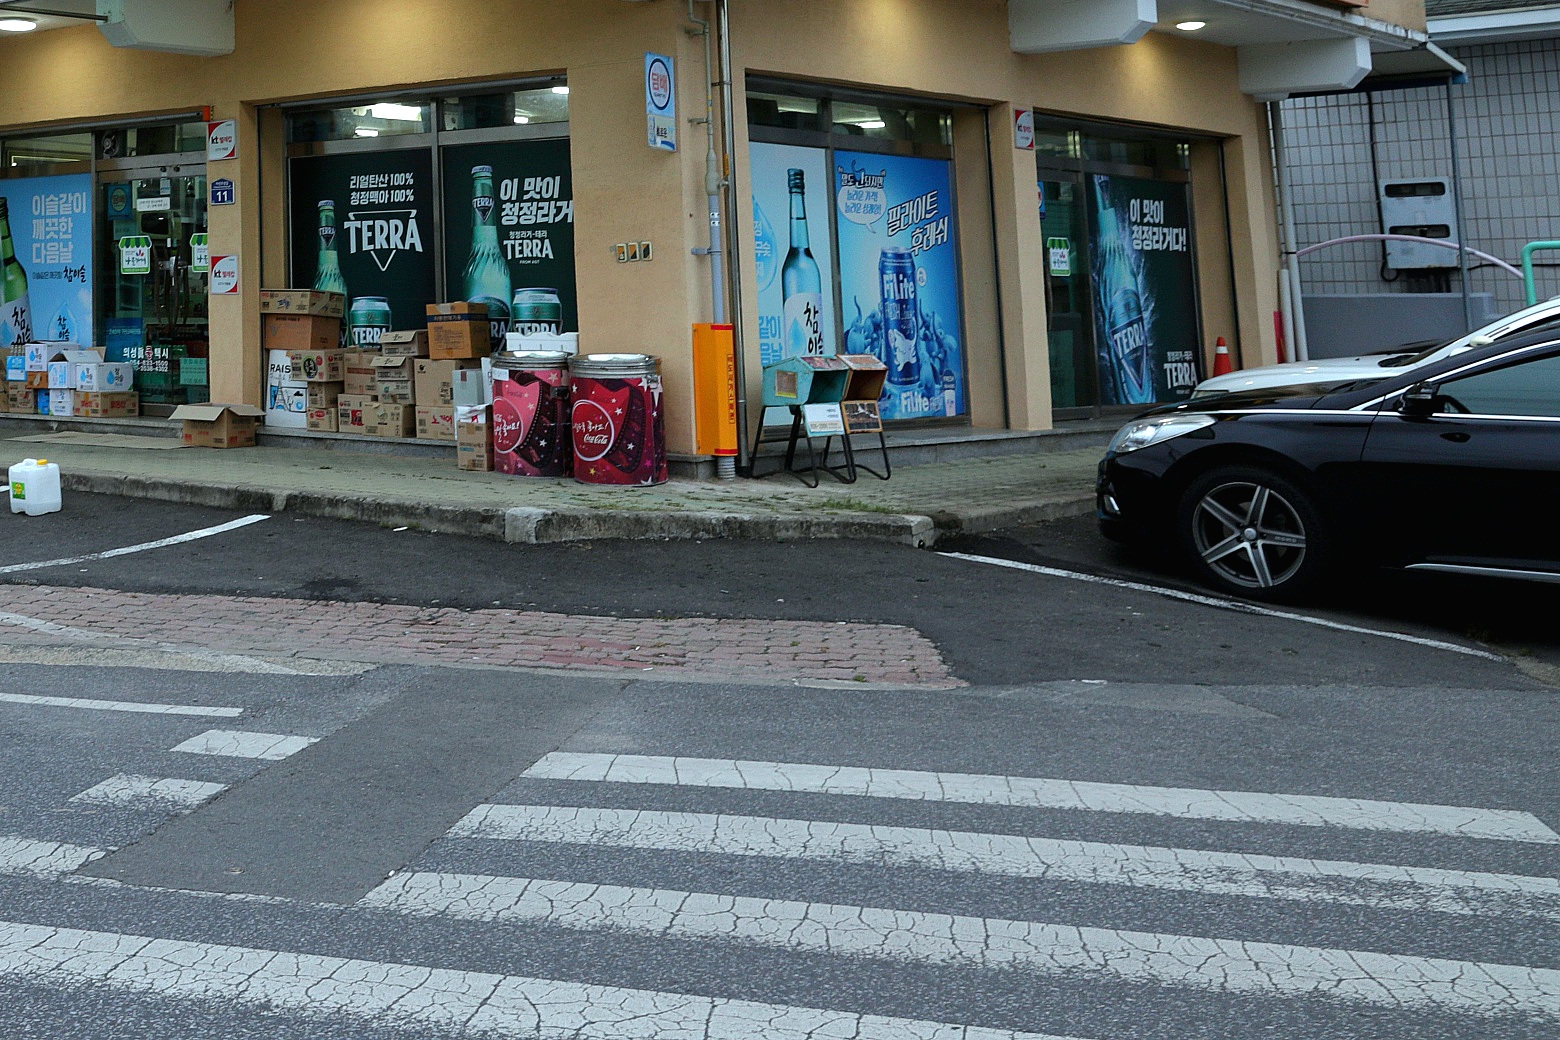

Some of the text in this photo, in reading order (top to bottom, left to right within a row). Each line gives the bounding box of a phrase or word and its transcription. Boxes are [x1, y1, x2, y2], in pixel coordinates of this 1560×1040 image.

[349, 172, 414, 189] 리얼탄산 100%
[500, 175, 561, 201] 이 맛이
[32, 192, 87, 216] 이슬같이
[216, 190, 228, 202] 11
[350, 188, 415, 206] 청정맥아 100%
[887, 190, 939, 237] 필라이트
[1130, 198, 1164, 224] 이 맛이
[32, 217, 73, 240] 깨끗한
[343, 217, 423, 254] TERRA
[910, 215, 949, 257] 후레쉬
[1131, 225, 1187, 252] 청정라거다!
[32, 241, 74, 264] 다음날
[503, 239, 554, 260] TERRA
[63, 264, 87, 283] 참이슬
[1163, 362, 1198, 390] TERRA
